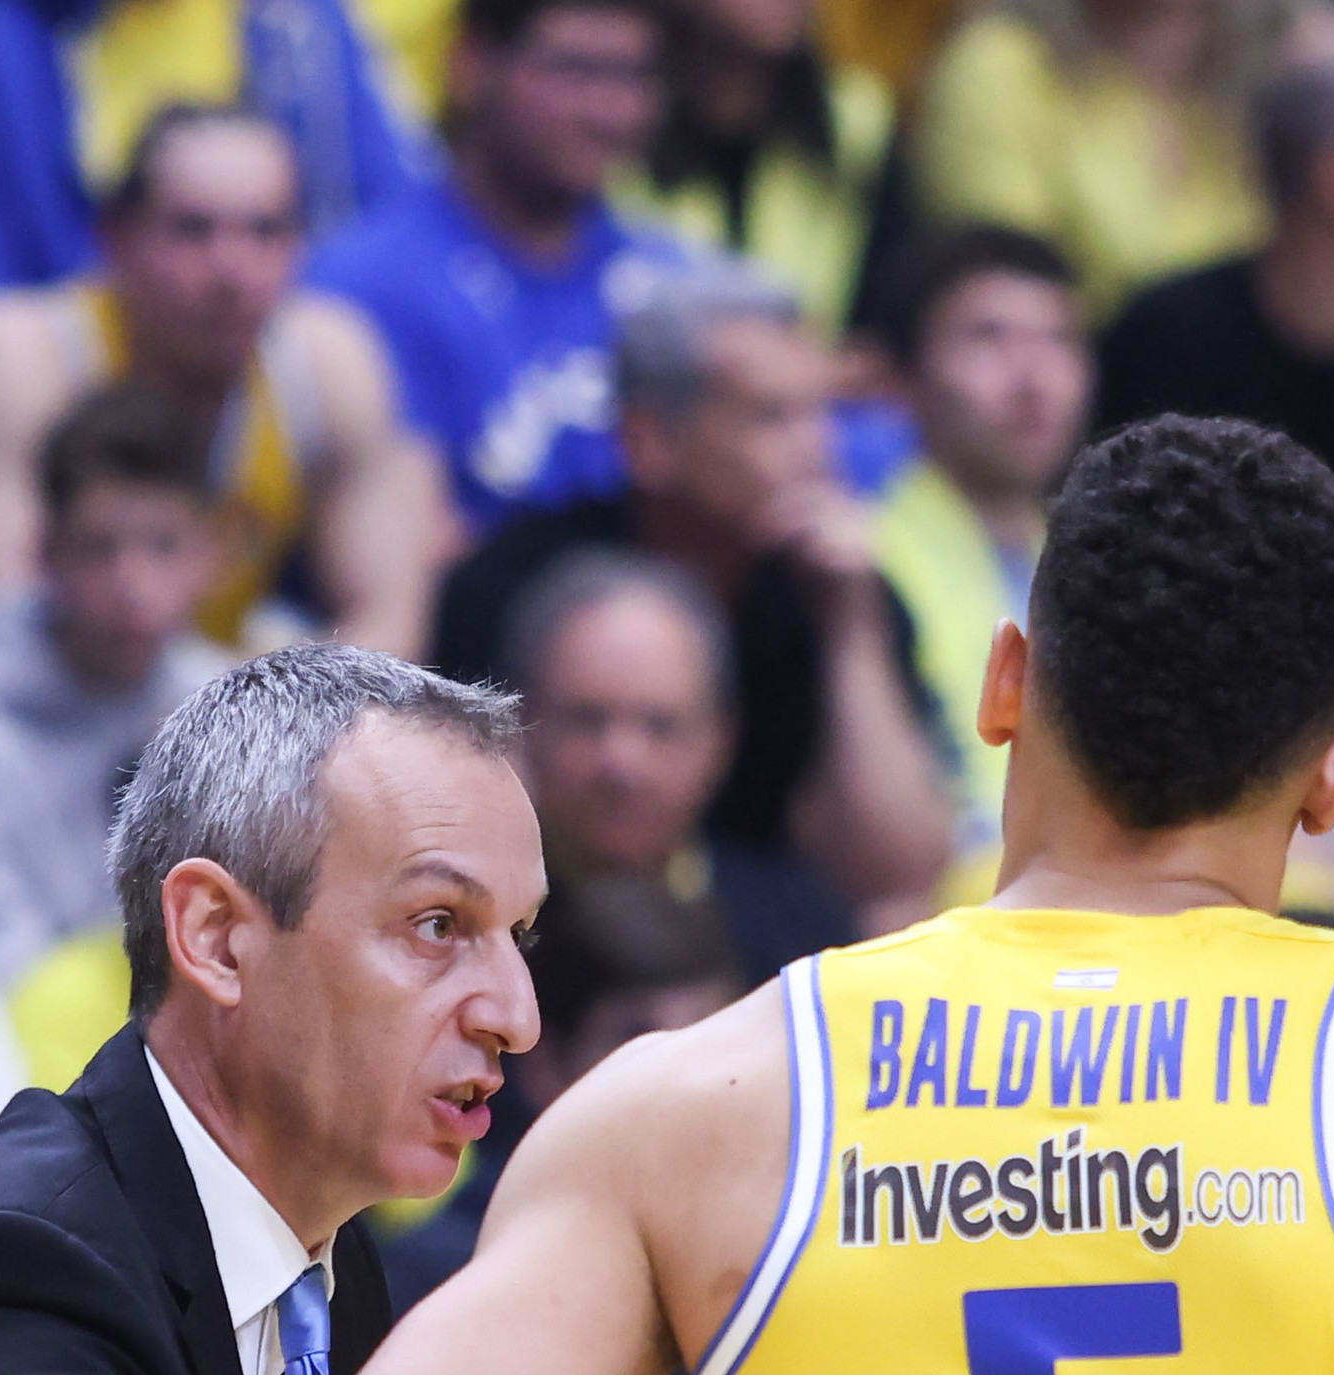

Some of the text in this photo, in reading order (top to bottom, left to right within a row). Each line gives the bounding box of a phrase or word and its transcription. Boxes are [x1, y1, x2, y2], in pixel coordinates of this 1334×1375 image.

[866, 996, 1287, 1109] BALDWIN IV
[839, 1128, 1305, 1252] Investing.com
